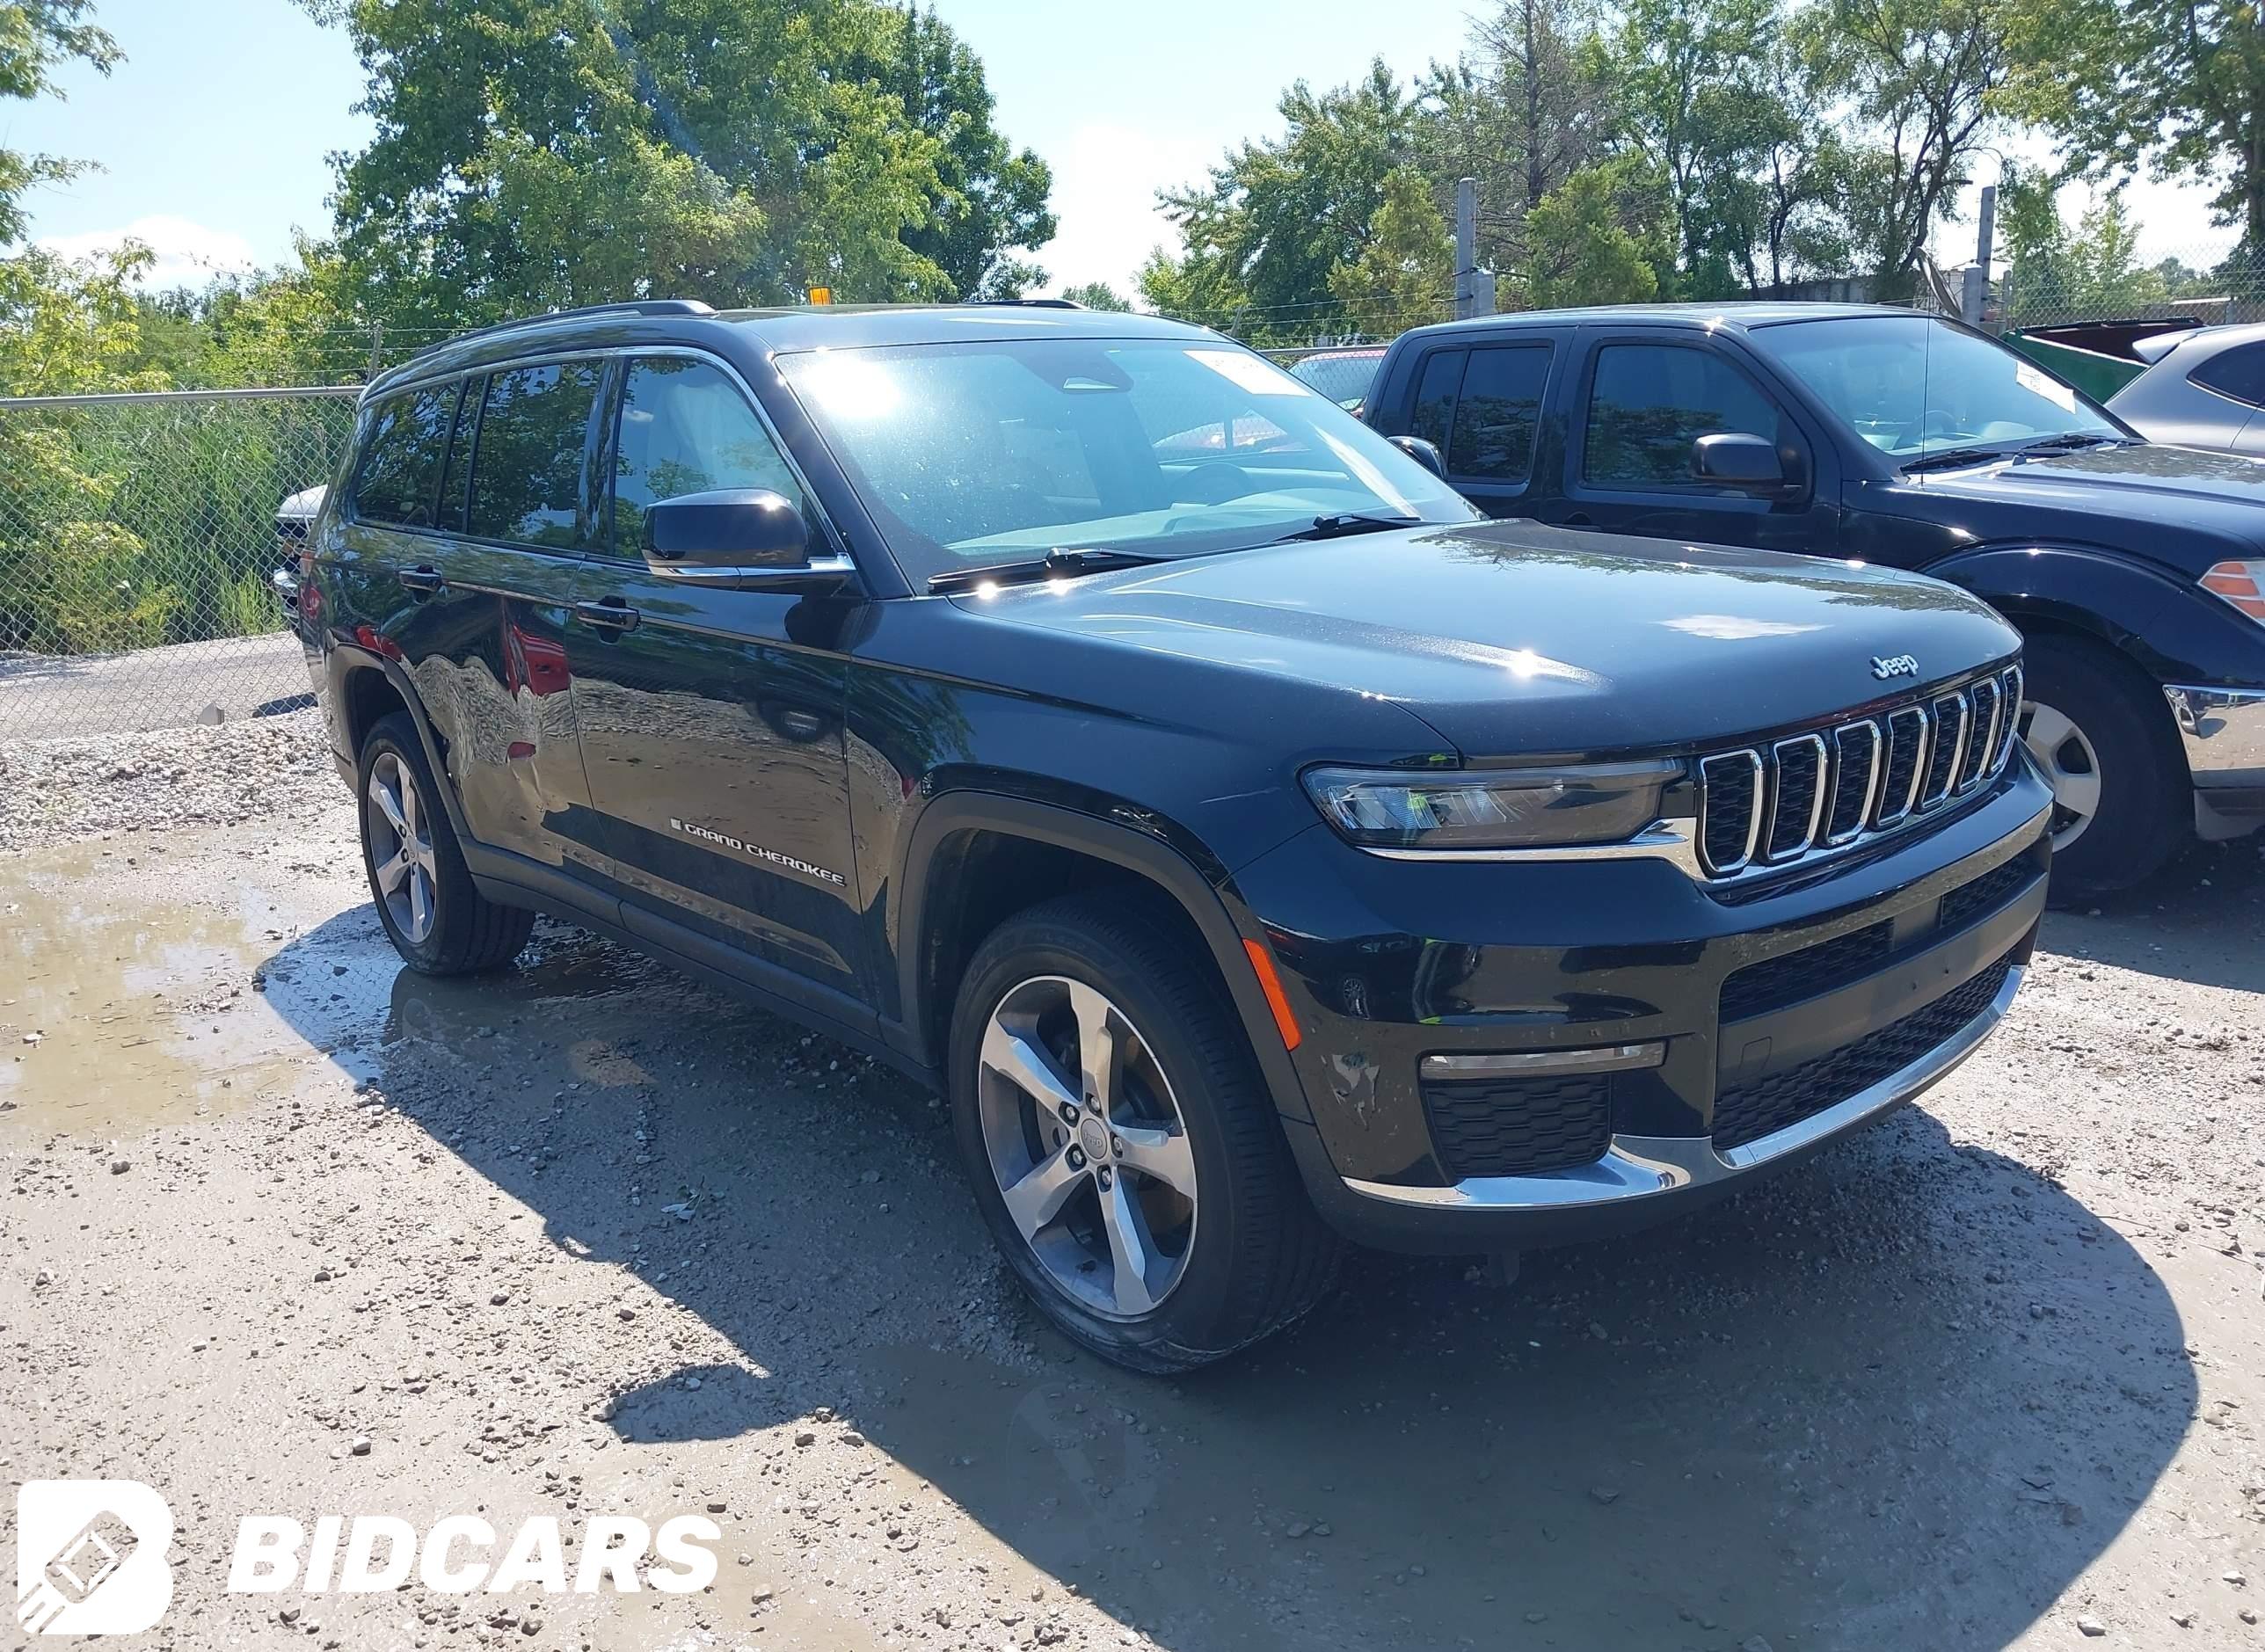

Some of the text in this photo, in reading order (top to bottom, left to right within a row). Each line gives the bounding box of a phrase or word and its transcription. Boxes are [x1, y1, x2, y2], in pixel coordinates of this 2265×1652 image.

[1870, 654, 1919, 680] Jeep
[684, 823, 846, 887] GRAND CHEROKEE
